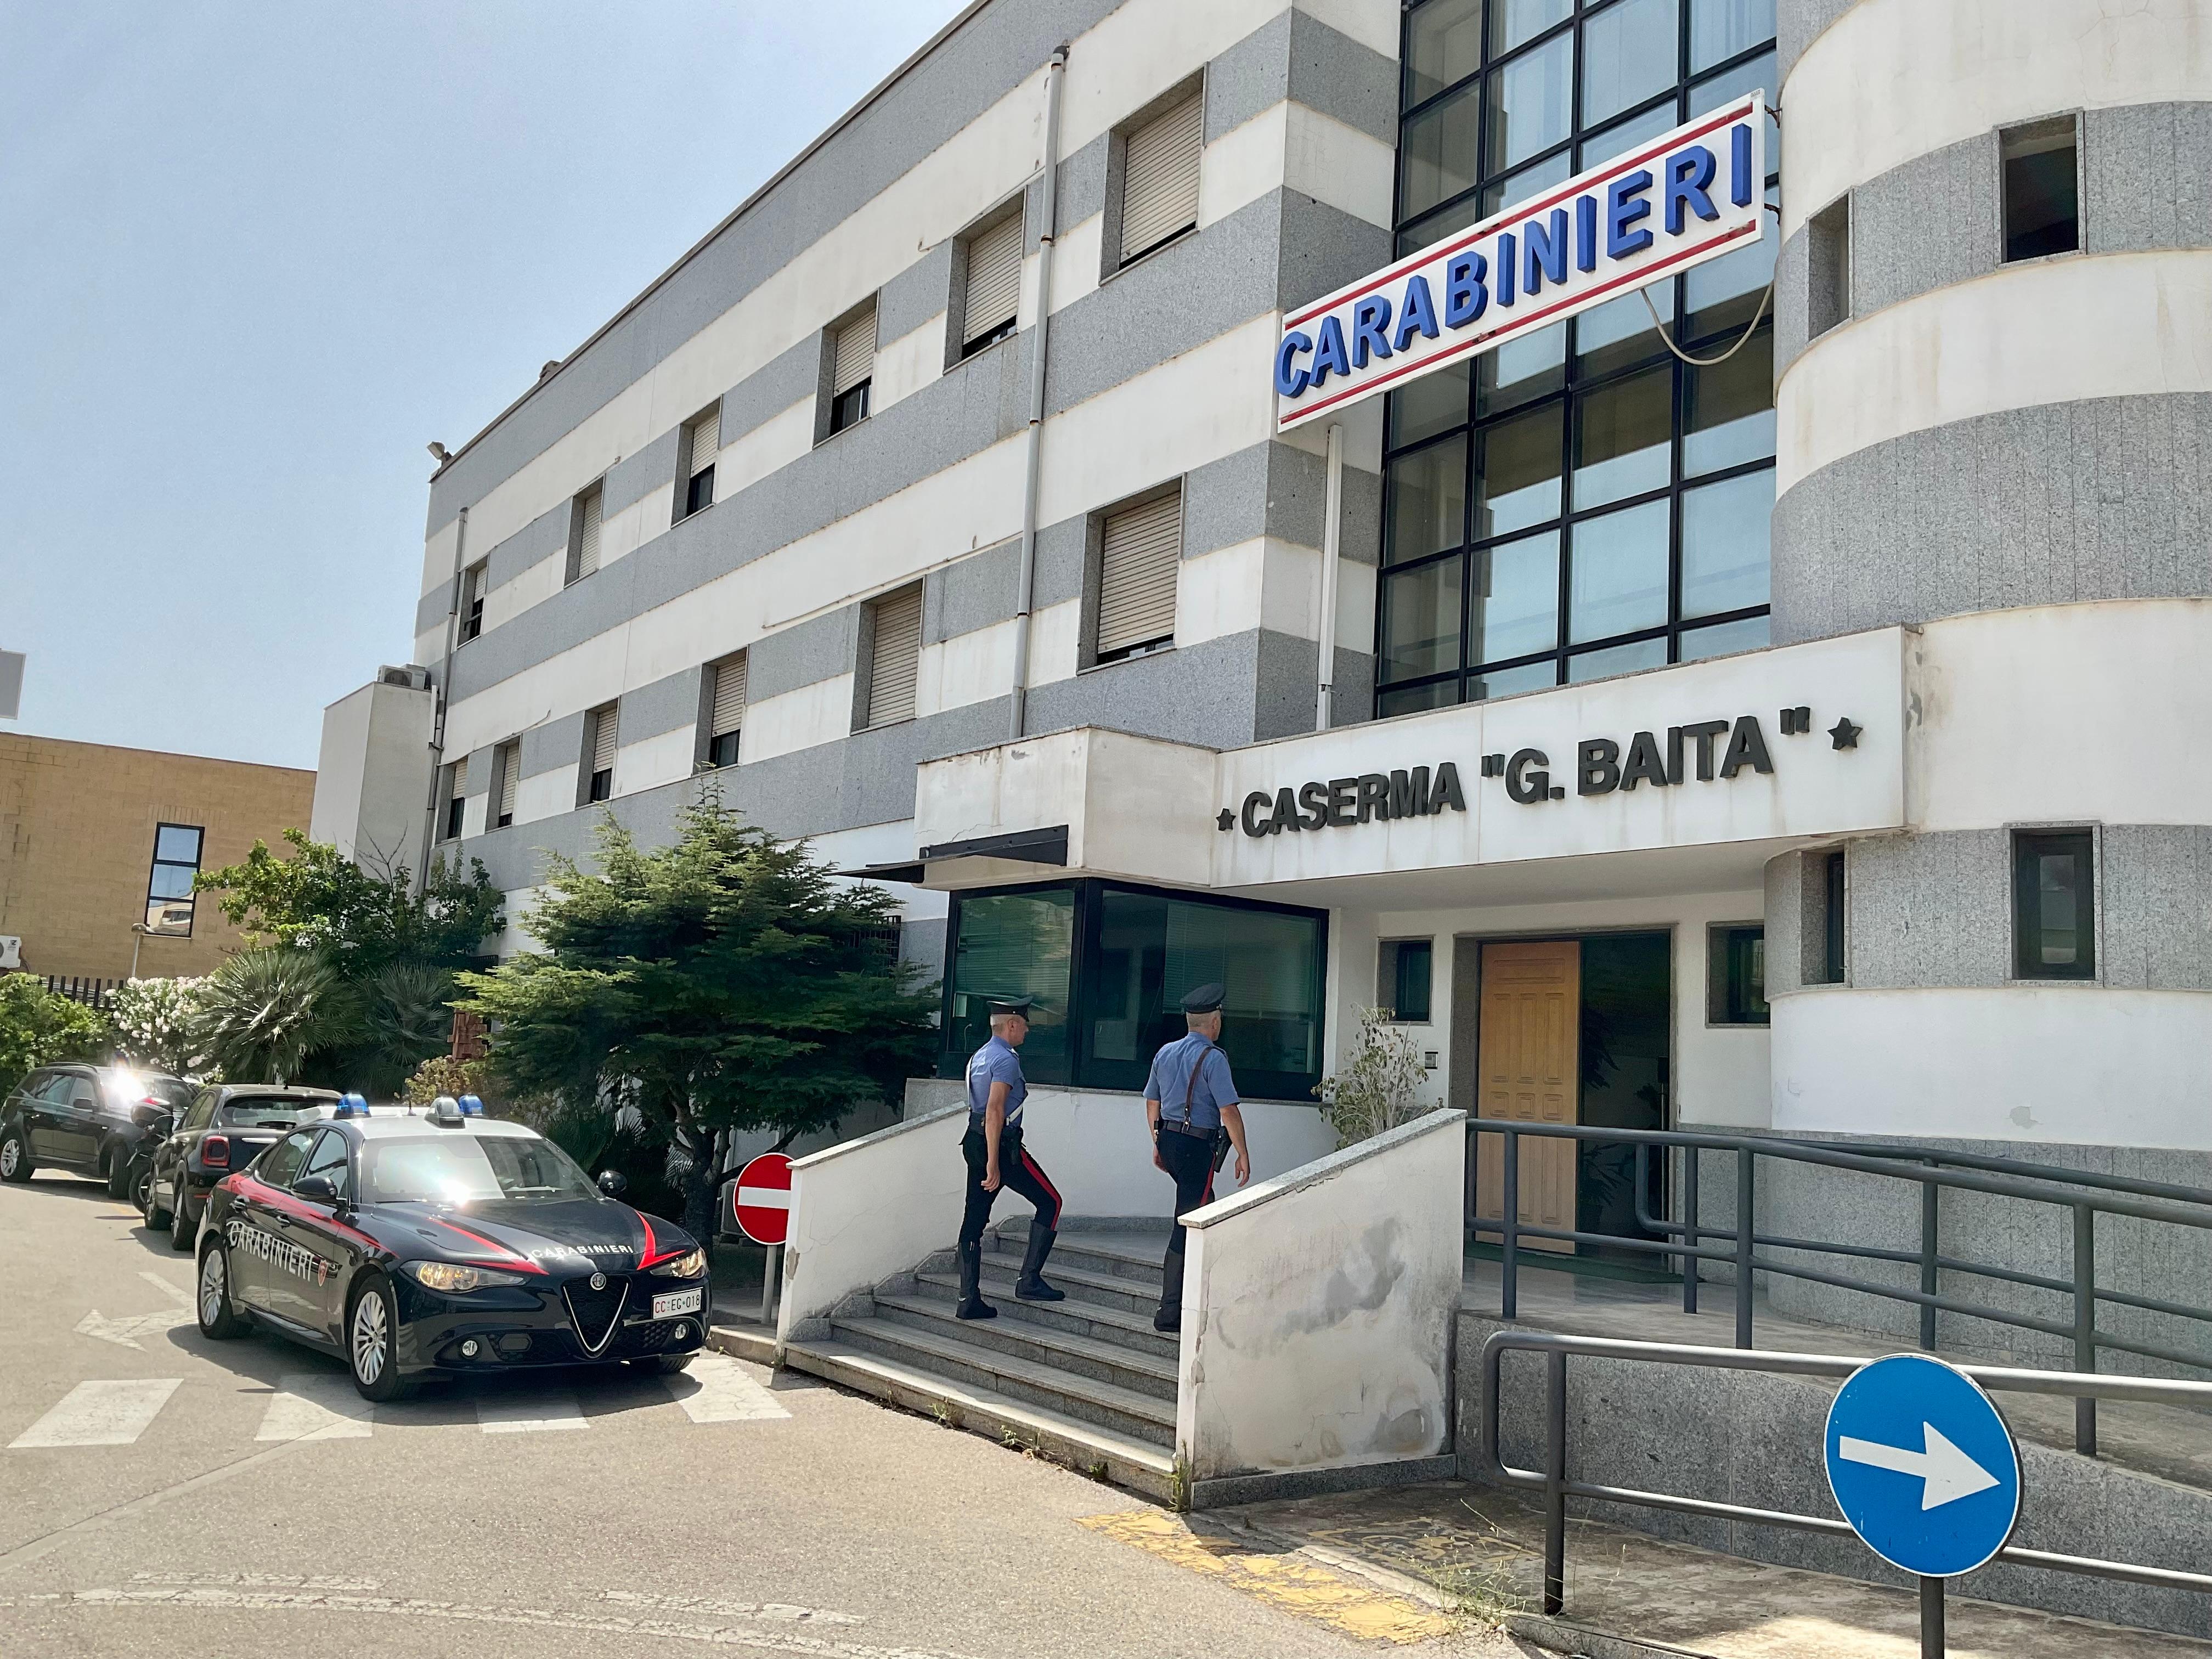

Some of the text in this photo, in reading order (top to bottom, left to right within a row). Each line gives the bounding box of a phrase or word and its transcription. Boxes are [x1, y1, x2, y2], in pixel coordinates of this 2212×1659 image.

[1275, 122, 1752, 398] CARABINIERI
[1242, 761, 1466, 838] CASERMA
[229, 1221, 315, 1282] CARABINIERI
[531, 1244, 634, 1258] CARABINIERI
